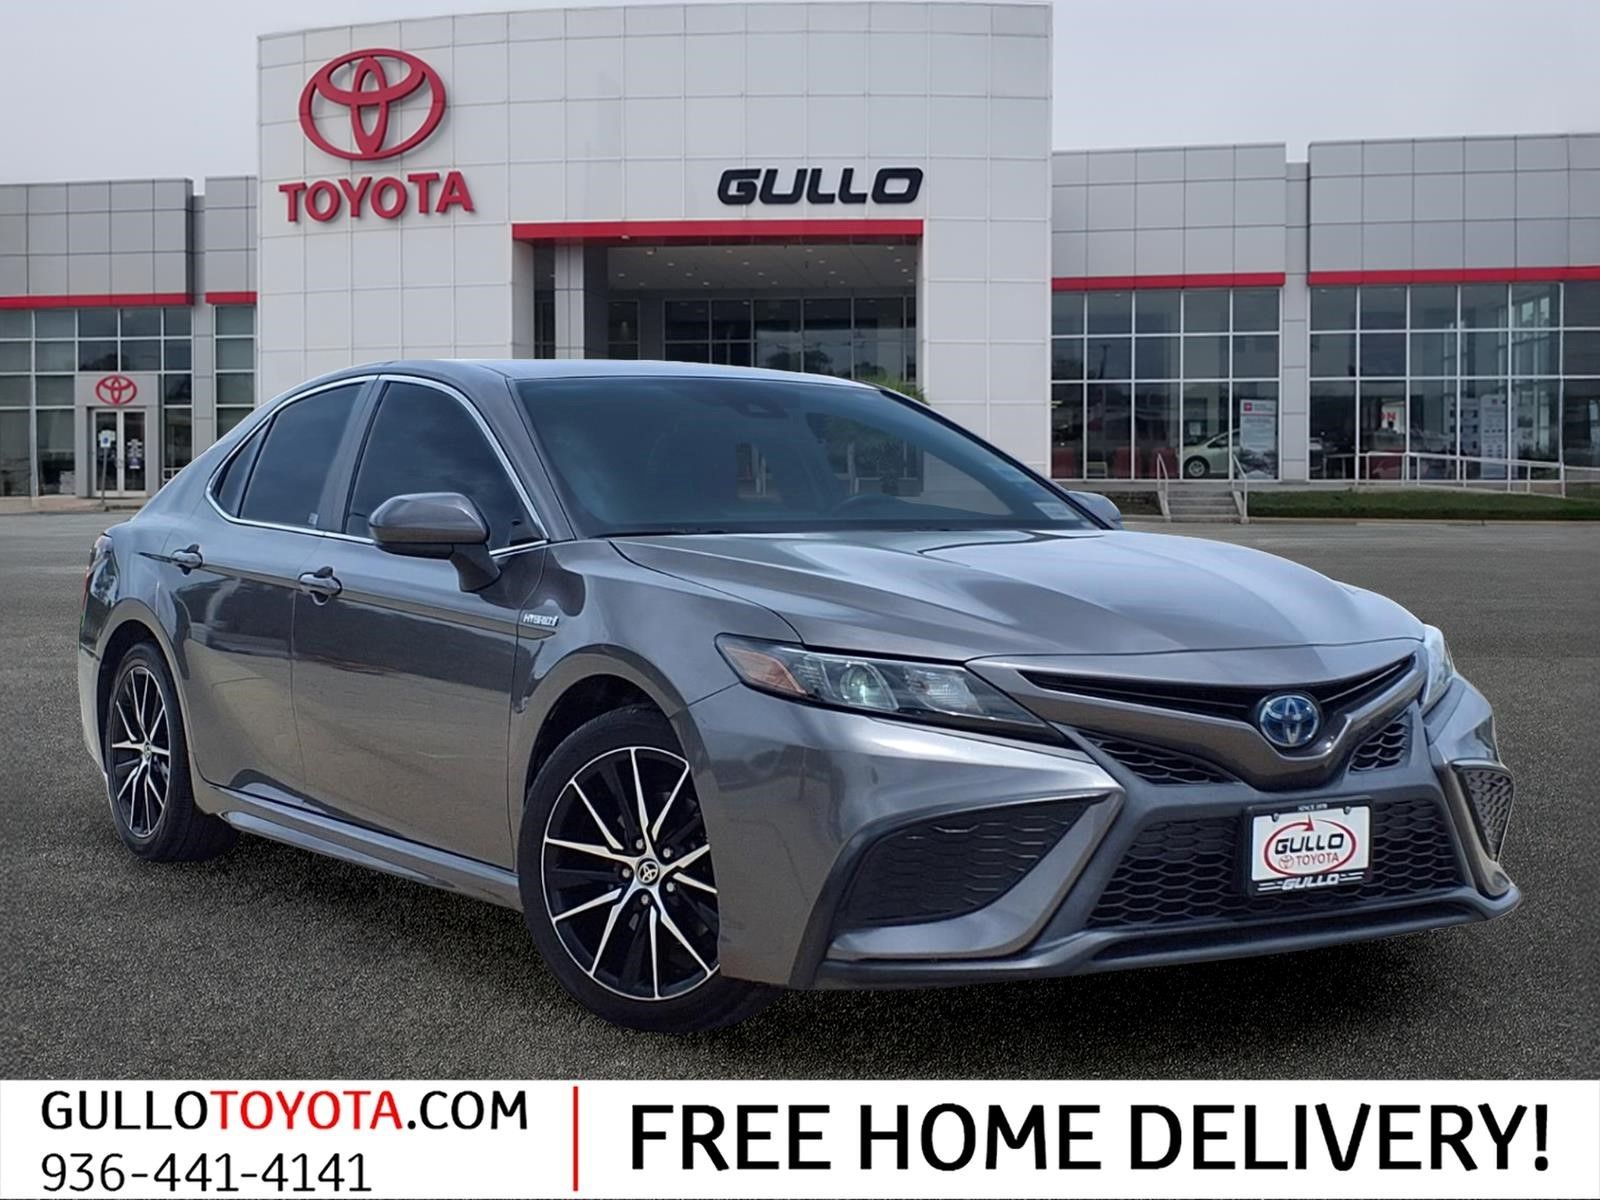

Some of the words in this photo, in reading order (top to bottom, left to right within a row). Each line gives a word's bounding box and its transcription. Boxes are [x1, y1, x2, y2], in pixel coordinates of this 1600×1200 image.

[717, 167, 924, 205] GULLO
[279, 170, 474, 222] TOYOTA
[523, 613, 554, 626] HYBRID
[1275, 833, 1344, 855] GULLO
[1296, 852, 1339, 866] TOYOTA
[1281, 874, 1340, 890] GULLO
